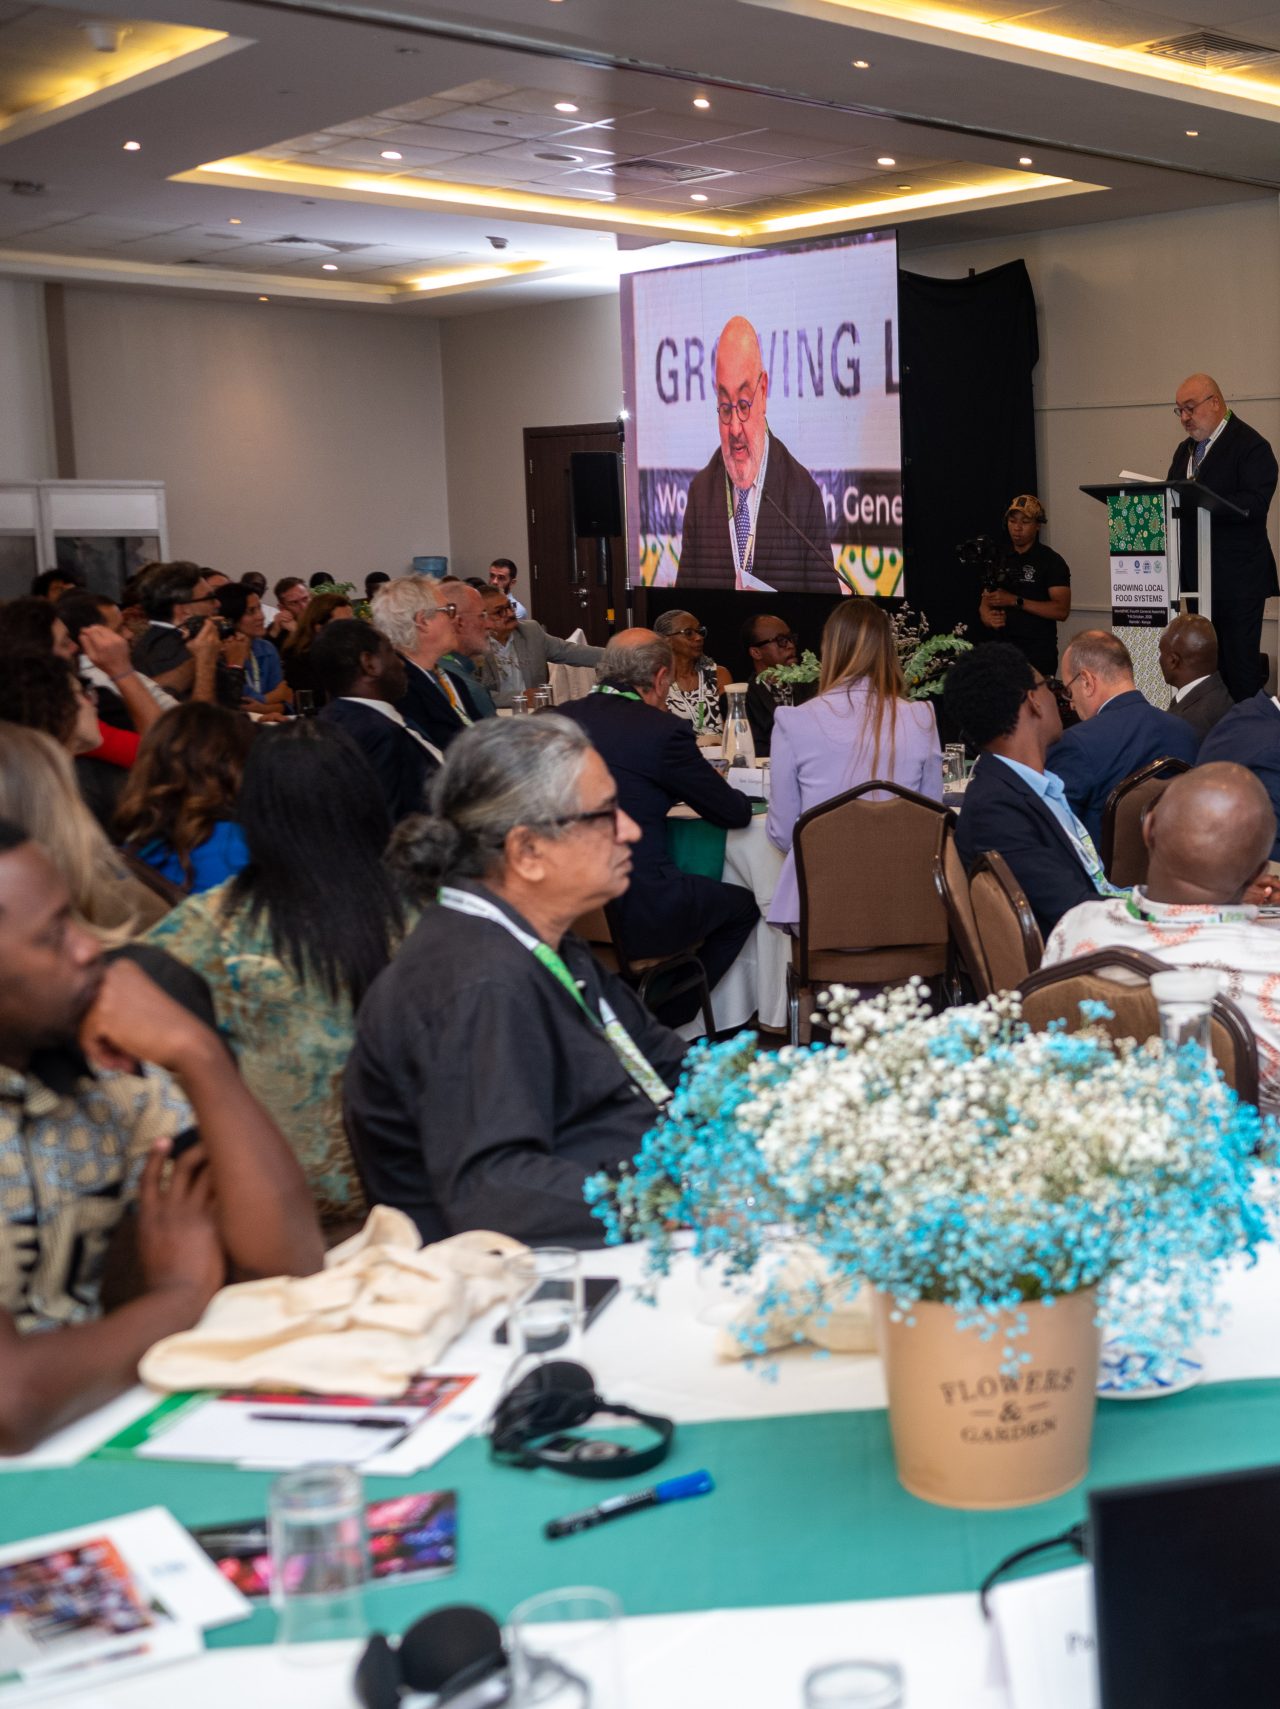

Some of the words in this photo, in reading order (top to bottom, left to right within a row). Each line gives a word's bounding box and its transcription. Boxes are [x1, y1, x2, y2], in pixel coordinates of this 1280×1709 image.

[1113, 584, 1144, 592] GROWING
[1144, 584, 1165, 592] LOCAL
[1115, 594, 1133, 602] FOOD
[1133, 594, 1163, 603] SYSTEMS
